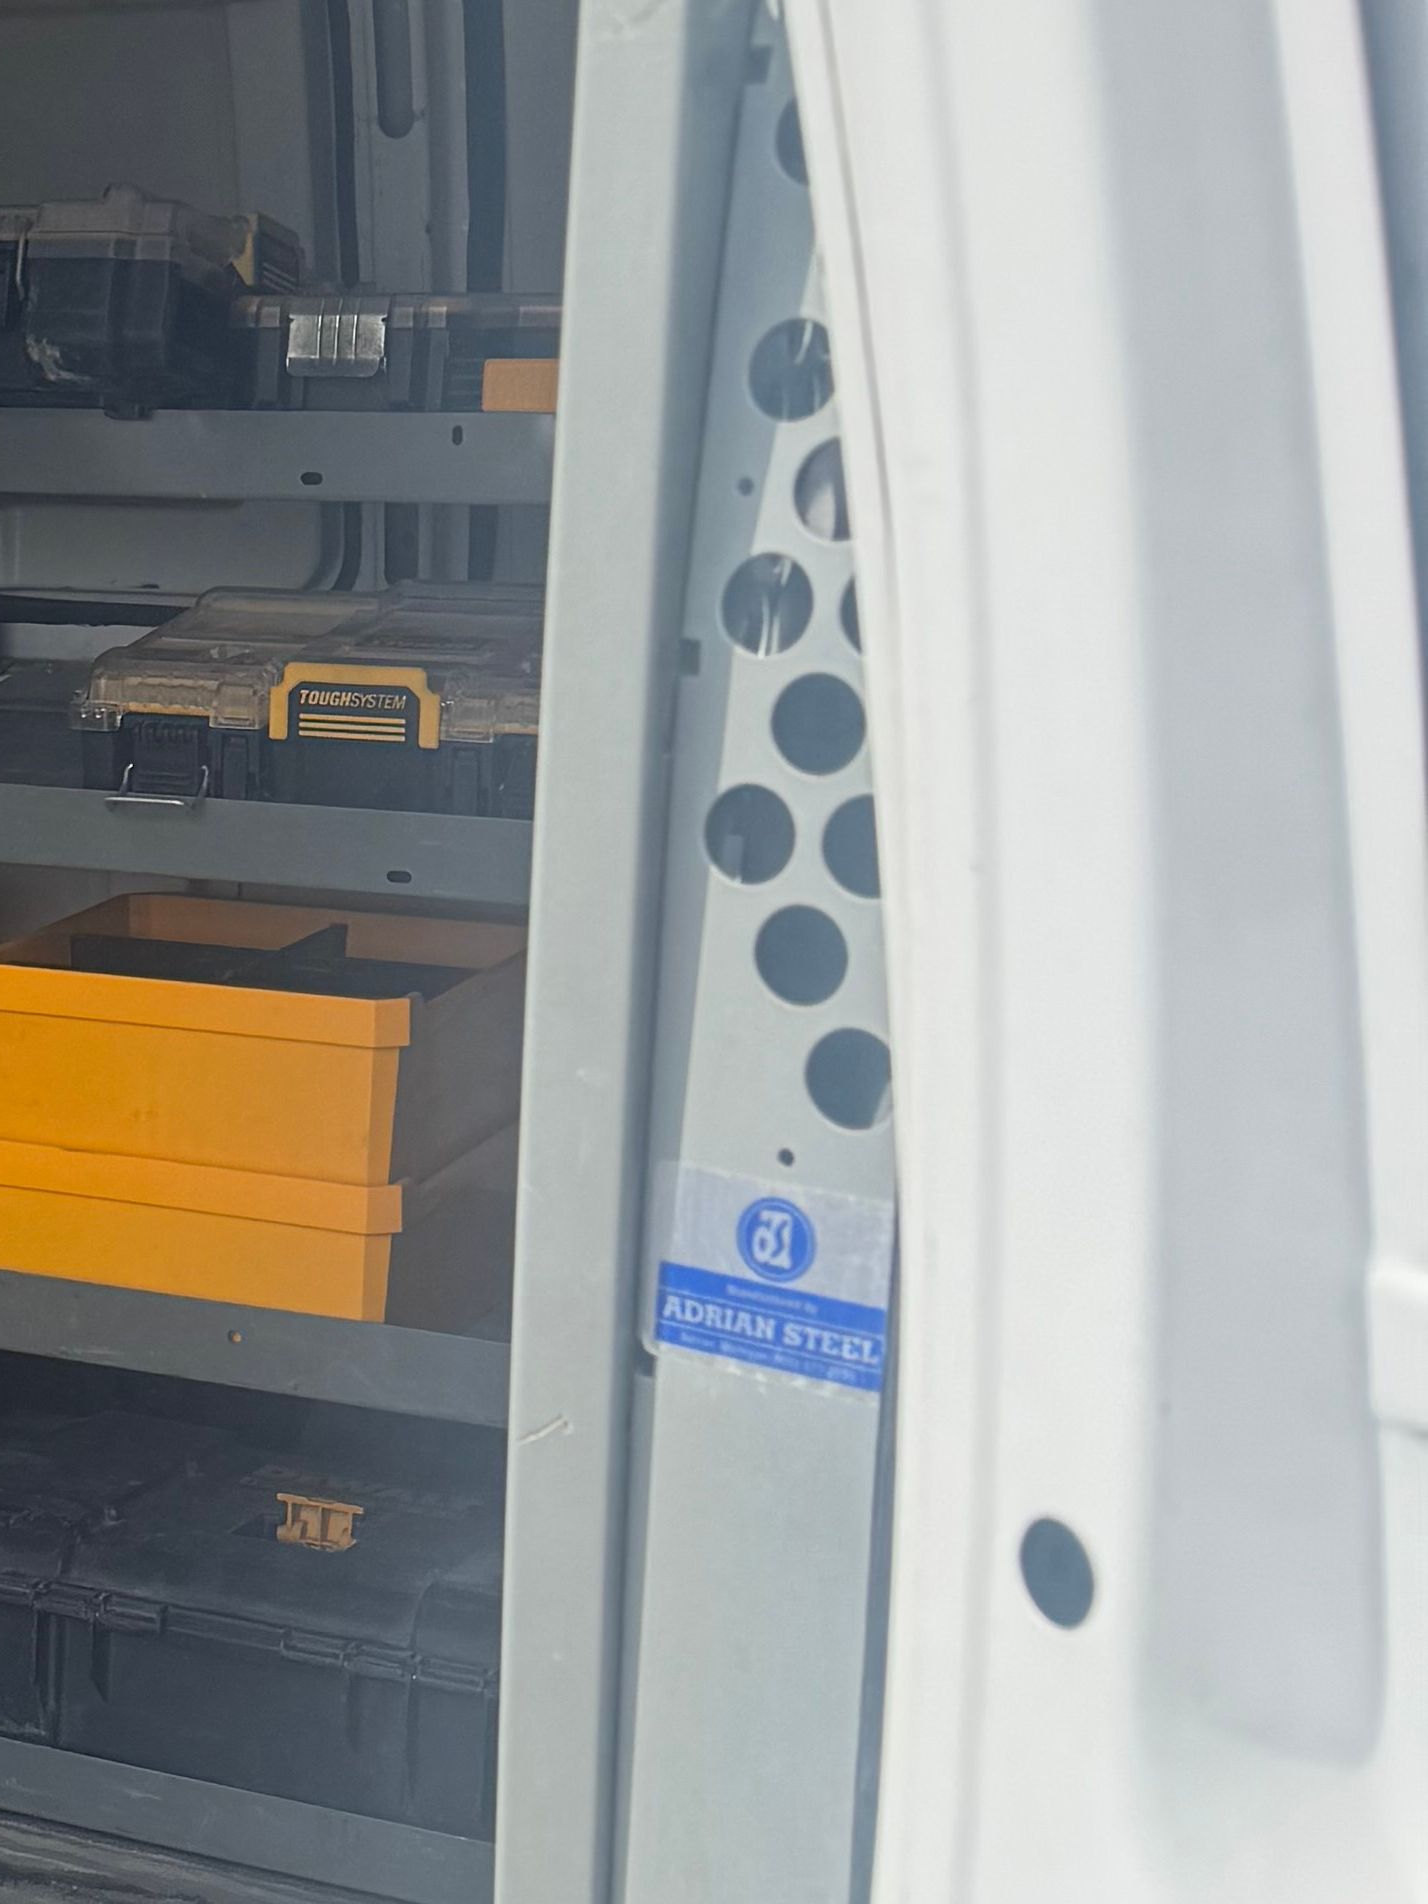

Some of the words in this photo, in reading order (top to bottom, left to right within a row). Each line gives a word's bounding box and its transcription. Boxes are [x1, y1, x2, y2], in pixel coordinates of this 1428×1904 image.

[299, 690, 407, 710] TOUGHSYSTEM
[663, 1295, 775, 1340] ADRIAN
[782, 1322, 879, 1365] STEEL
